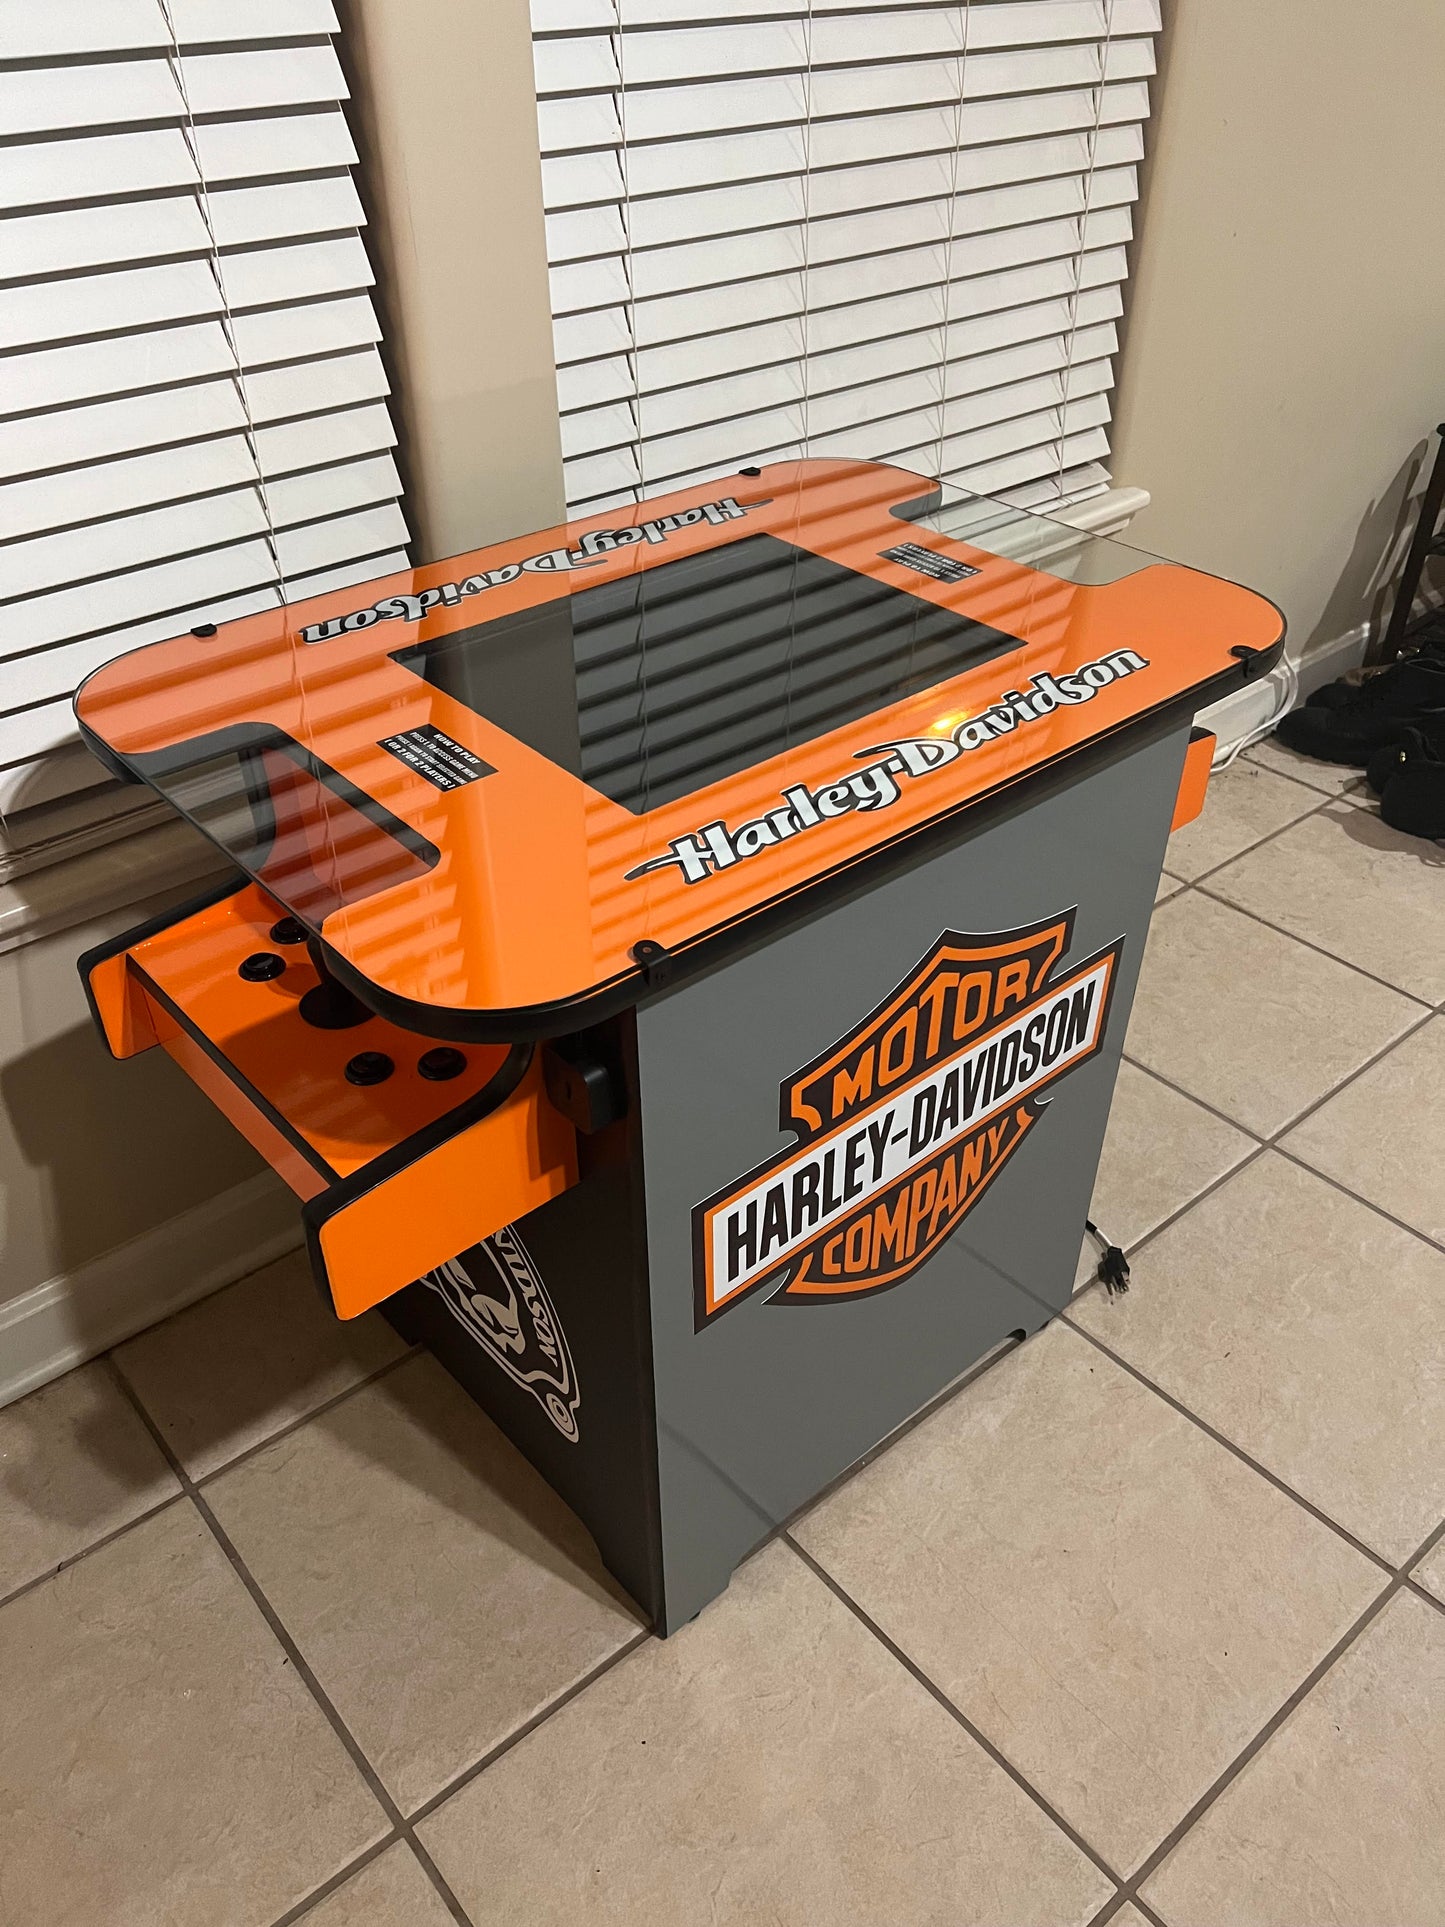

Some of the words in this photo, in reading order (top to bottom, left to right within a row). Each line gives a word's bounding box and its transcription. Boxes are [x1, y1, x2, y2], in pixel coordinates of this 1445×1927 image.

[299, 497, 773, 645] Harley-Davidson
[387, 741, 402, 749] OR
[401, 751, 420, 762] FOR
[419, 764, 452, 786] PLAYERS
[433, 733, 455, 746] HOW
[450, 744, 465, 753] TO
[459, 751, 481, 764] PLAY
[624, 647, 1150, 884] Harley-Davidson
[832, 958, 1030, 1120] MOTOR
[727, 980, 1097, 1283] HARLEY-DAVIDSON
[823, 1117, 1011, 1276] COMPANY
[491, 1228, 558, 1367] VIDSON
